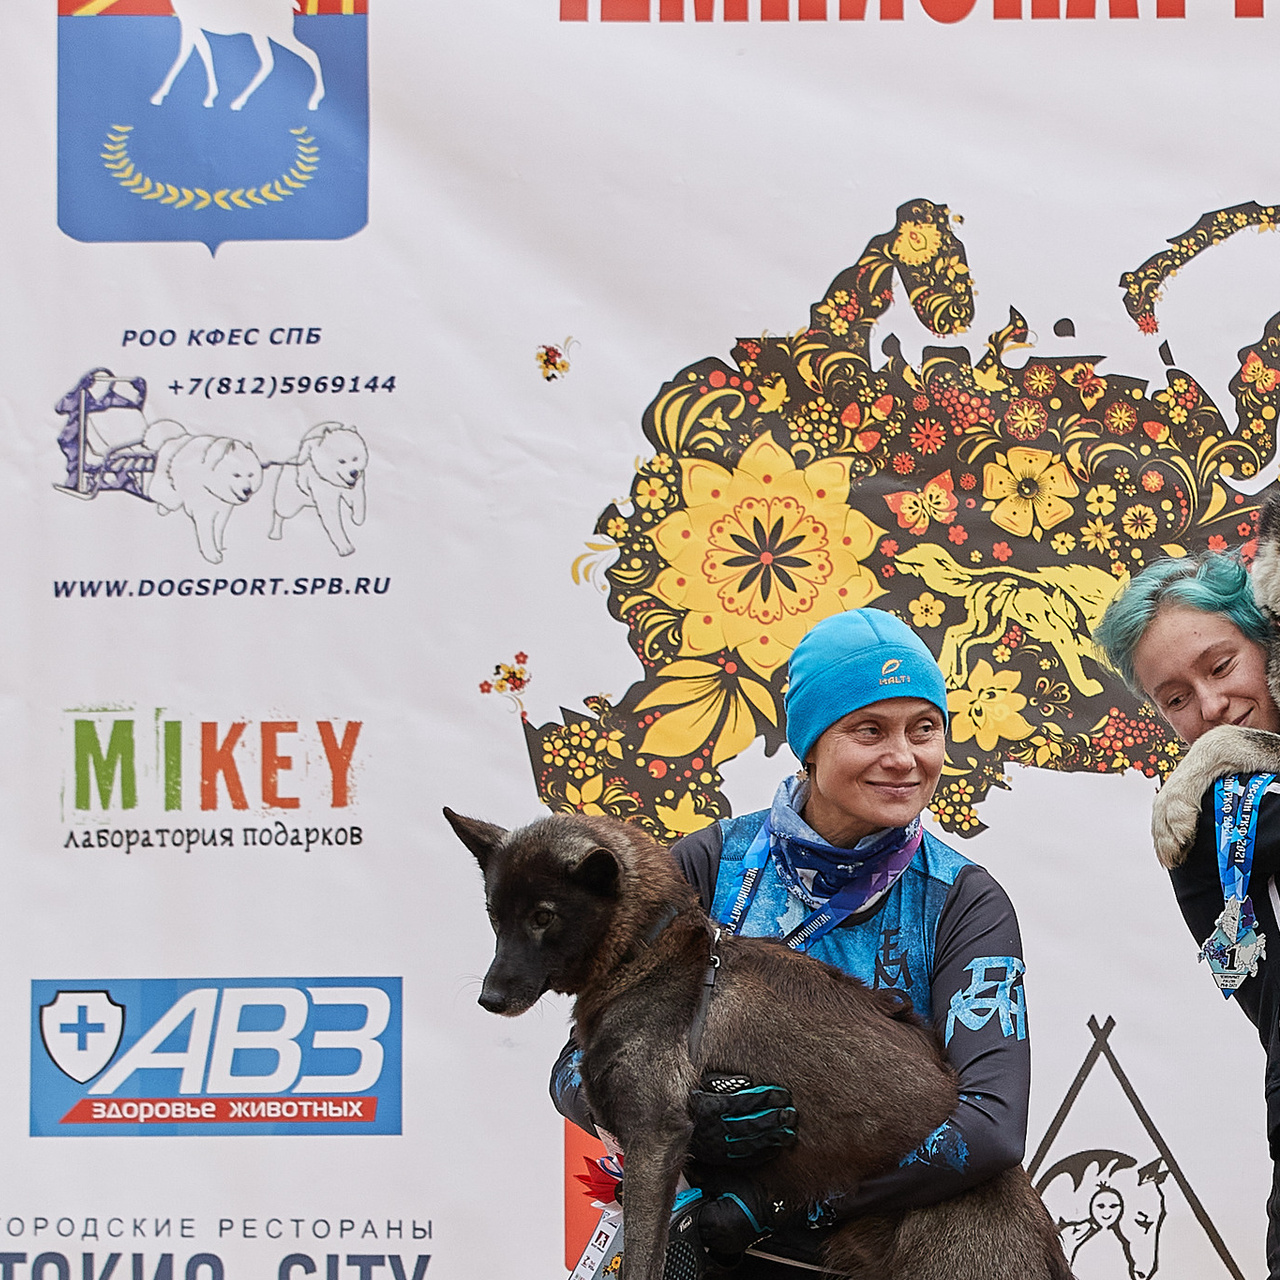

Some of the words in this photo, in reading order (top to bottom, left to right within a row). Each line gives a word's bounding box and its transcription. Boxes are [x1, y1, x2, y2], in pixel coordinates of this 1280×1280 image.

[121, 329, 177, 347] РОО
[187, 328, 260, 347] КФЕС
[269, 327, 323, 346] СПБ
[168, 376, 397, 400] +7(812)5969144
[52, 577, 392, 598] WWW.DOGSPORT.SPB.RU
[73, 719, 363, 811] MIKEY
[1237, 814, 1250, 836] РКФ
[64, 828, 234, 854] лаборатория
[243, 821, 363, 852] подарков
[1234, 838, 1247, 863] 2021
[1225, 948, 1237, 970] 1
[88, 987, 391, 1095] АВЗ
[0, 1217, 195, 1241] ОРОДСКИЕ
[219, 1218, 433, 1240] РЕСТОРАНЫ
